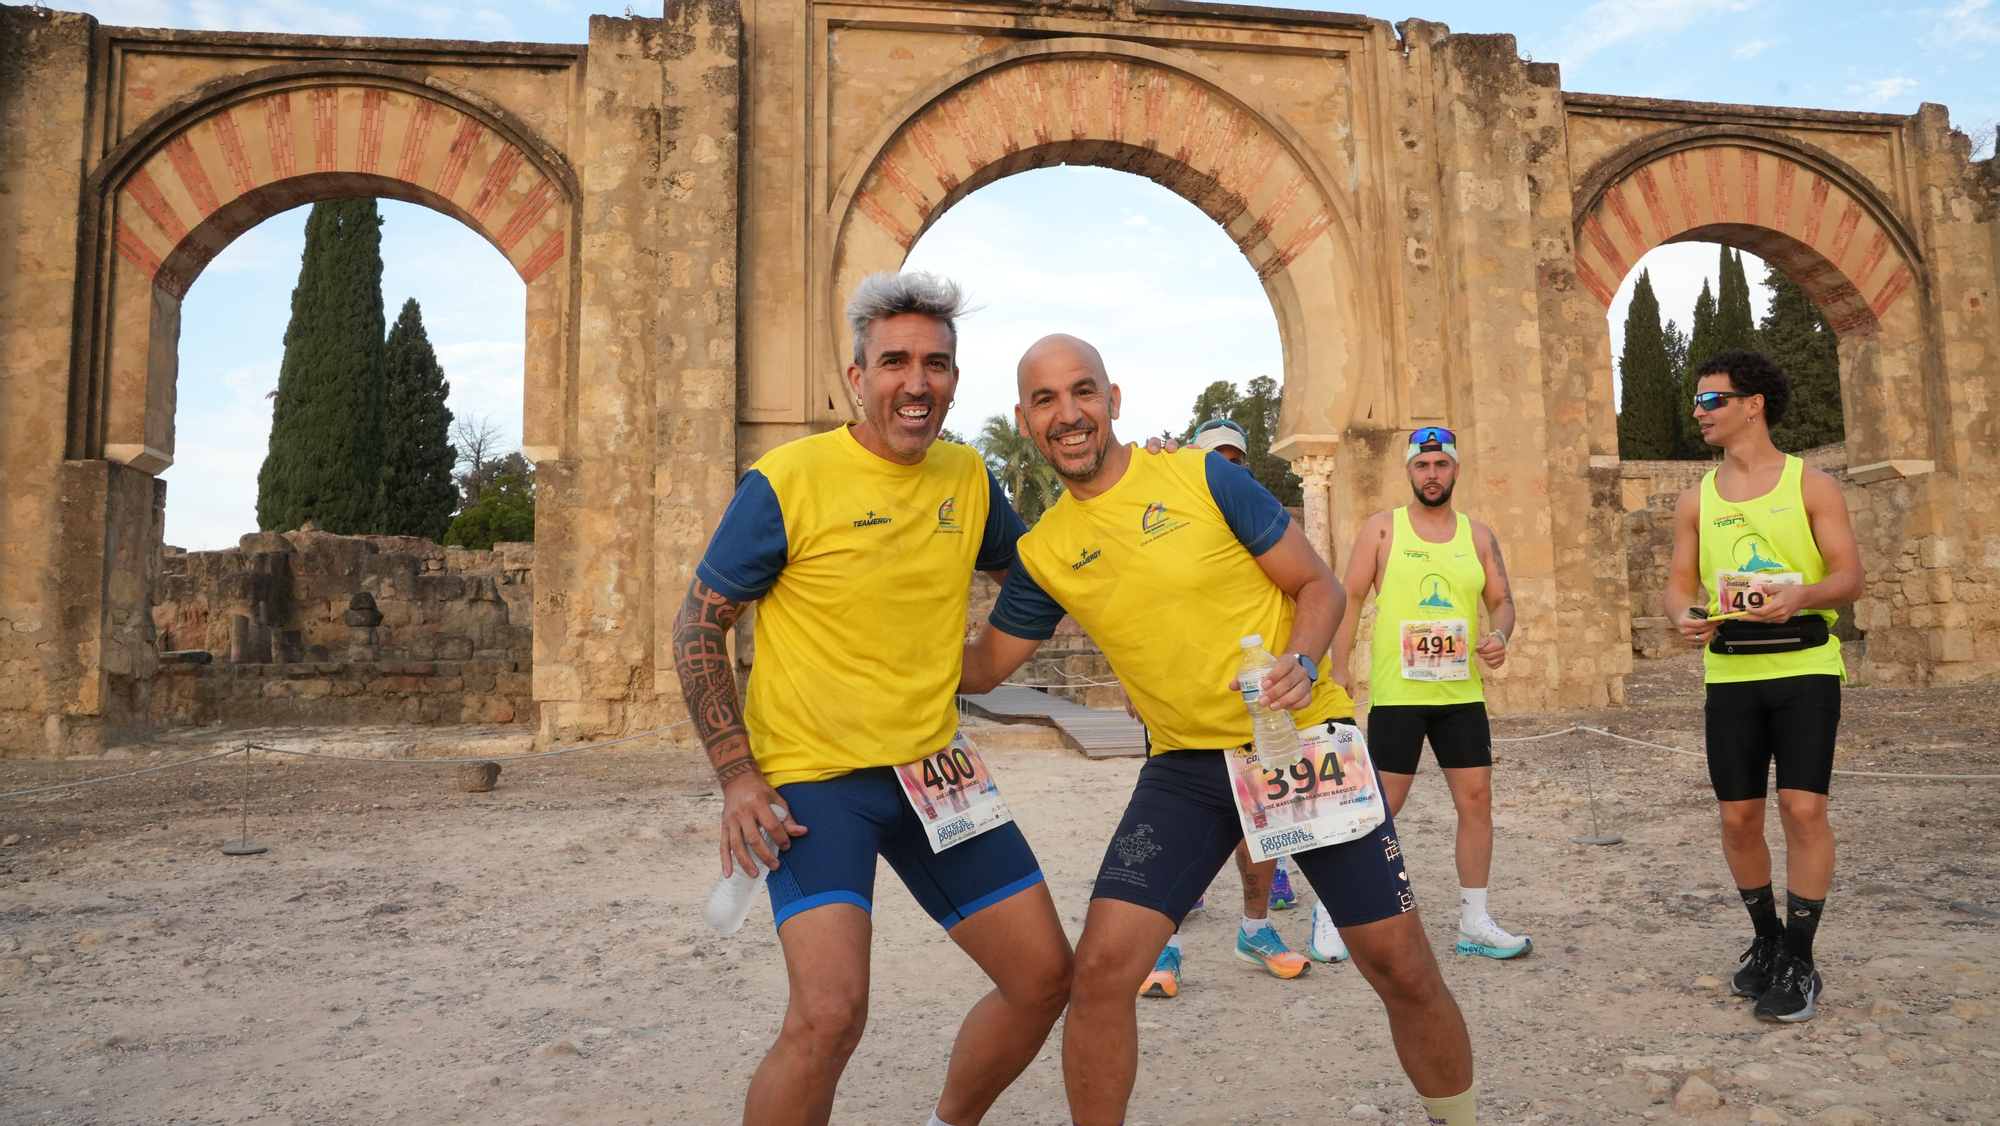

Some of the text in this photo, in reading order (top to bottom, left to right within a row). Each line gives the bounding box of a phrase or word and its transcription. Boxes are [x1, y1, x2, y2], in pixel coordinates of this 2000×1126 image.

[853, 518, 892, 528] TEAMERGY
[1072, 549, 1102, 571] TEAMERGY
[1732, 592, 1772, 612] 49
[1417, 636, 1456, 654] 491
[922, 748, 974, 790] 400
[1262, 752, 1346, 800] 394
[1262, 804, 1275, 812] JOSÉ
[1276, 799, 1298, 809] MANUEL
[1331, 786, 1357, 796] MÁRQUEZ
[1340, 795, 1372, 806] serizona
[937, 818, 966, 836] carreras
[938, 821, 974, 844] populares
[1260, 828, 1304, 846] carreras
[1262, 833, 1314, 854] populares
[1264, 848, 1290, 859] Diputación
[1297, 842, 1317, 850] Córdoba
